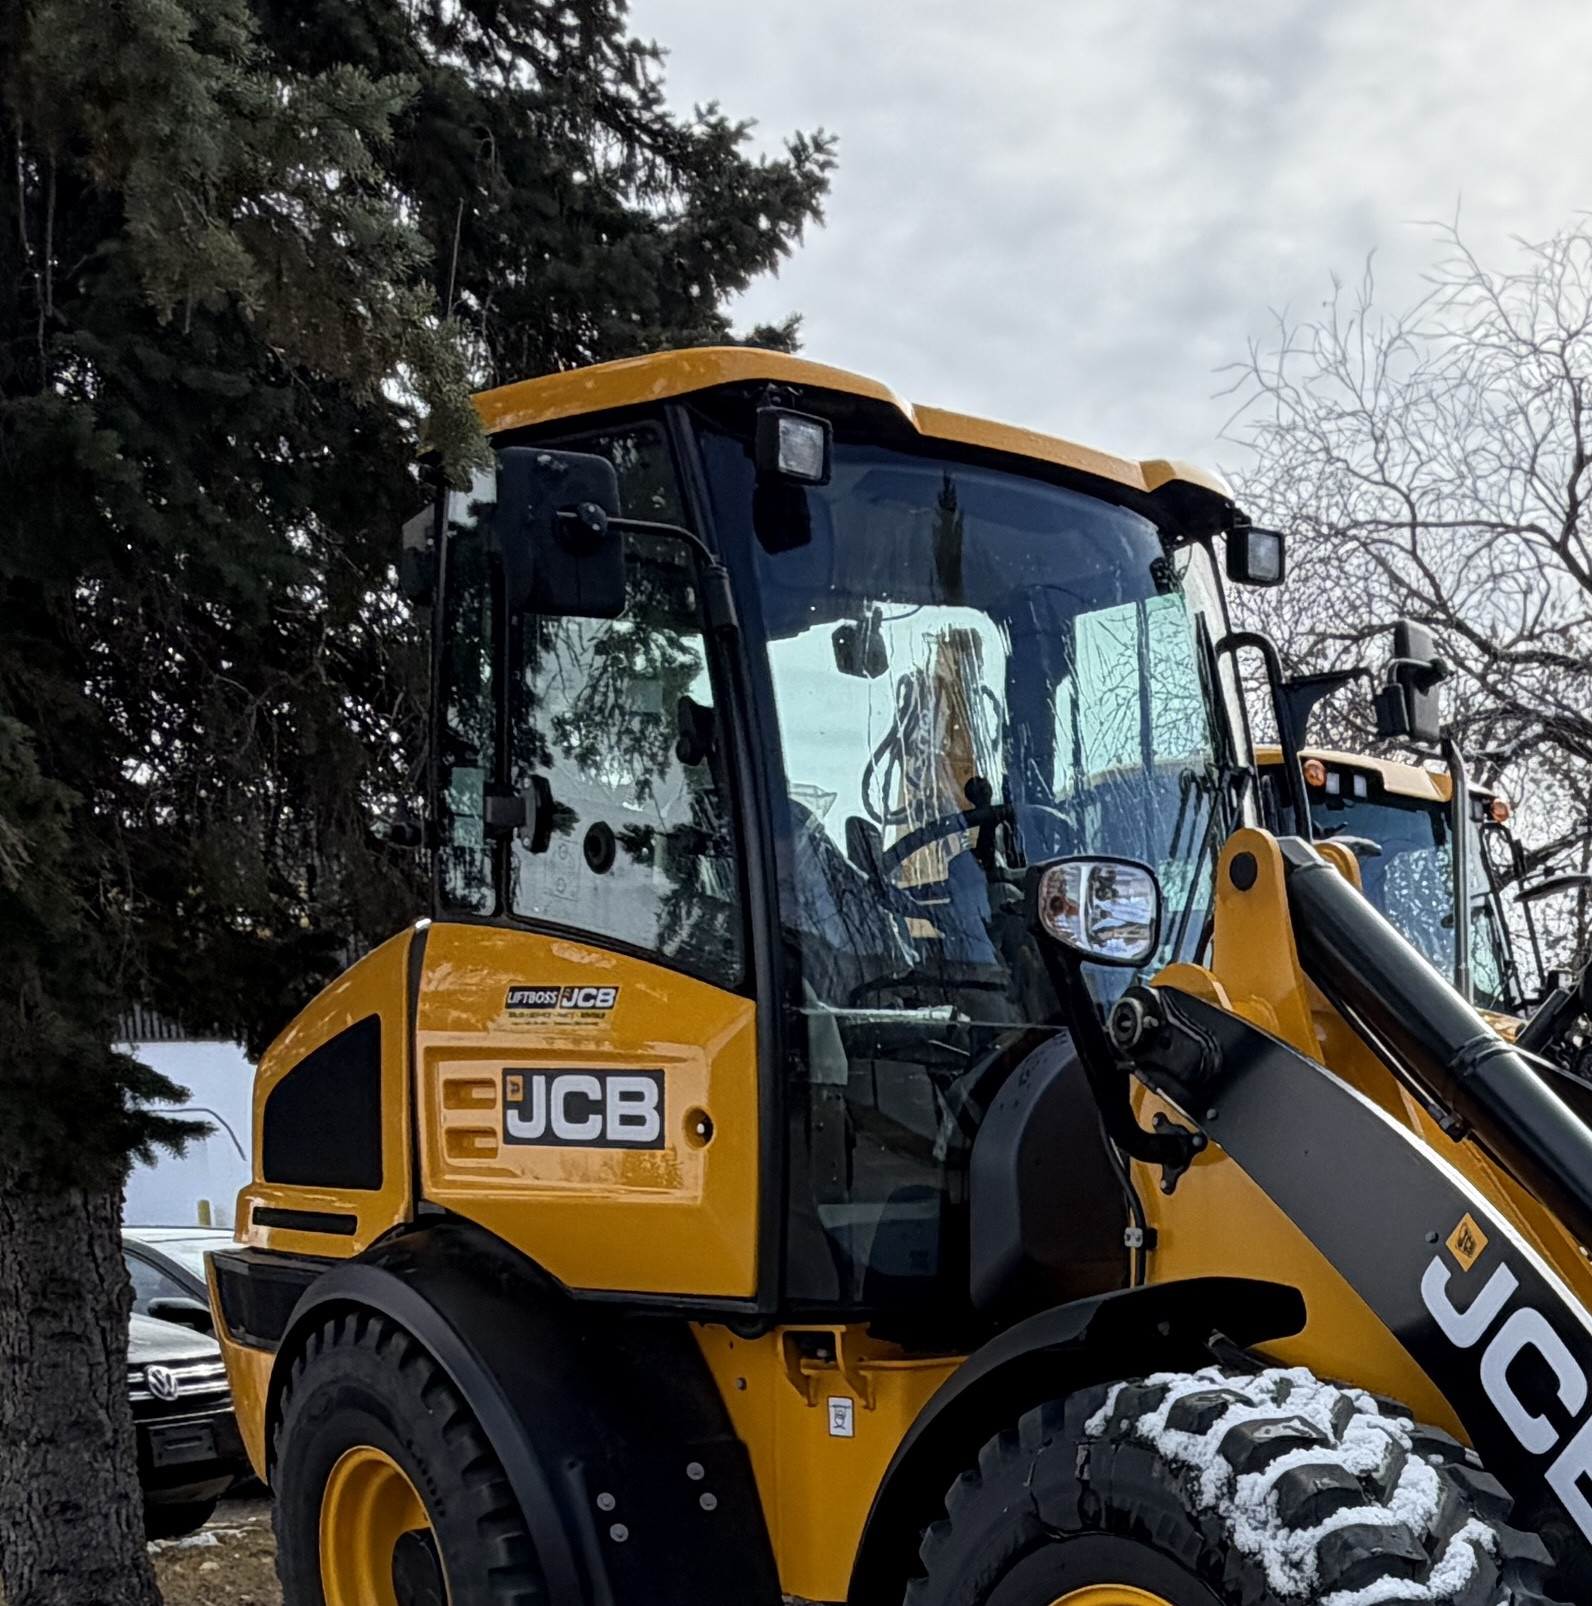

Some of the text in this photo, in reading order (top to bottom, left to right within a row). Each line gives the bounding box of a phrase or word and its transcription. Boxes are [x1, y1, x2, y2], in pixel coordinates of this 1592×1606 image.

[506, 987, 617, 1008] LIFTBOSS JCB
[505, 1074, 661, 1143] JCB
